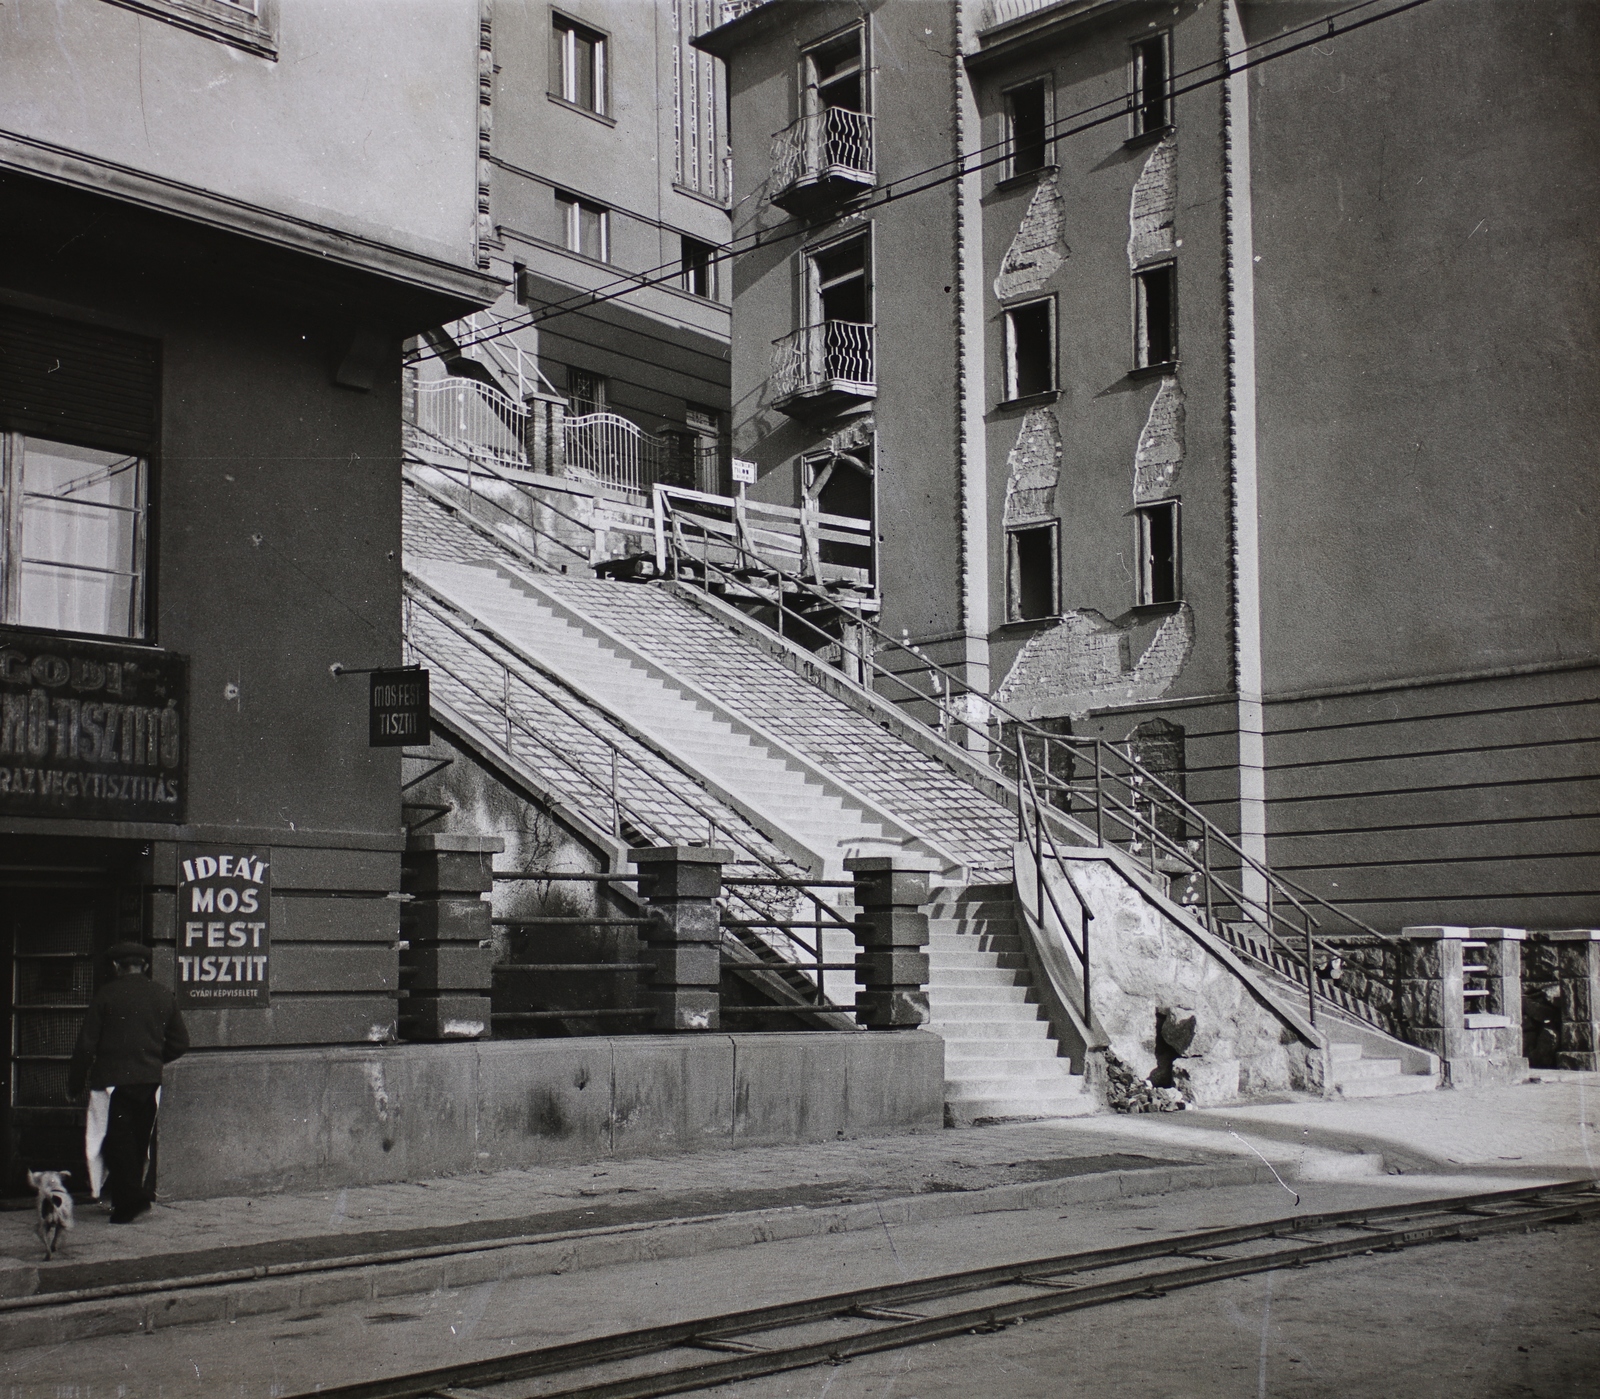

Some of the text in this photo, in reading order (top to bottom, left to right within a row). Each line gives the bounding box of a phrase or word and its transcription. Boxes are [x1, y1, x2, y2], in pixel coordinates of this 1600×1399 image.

[379, 712, 418, 735] TISZTIT
[38, 769, 179, 803] VEGYTISZTITÁS
[191, 887, 259, 914] MOS
[185, 921, 266, 948] FEST
[178, 955, 267, 982] TISZTIT
[189, 987, 212, 998] GYÁRI
